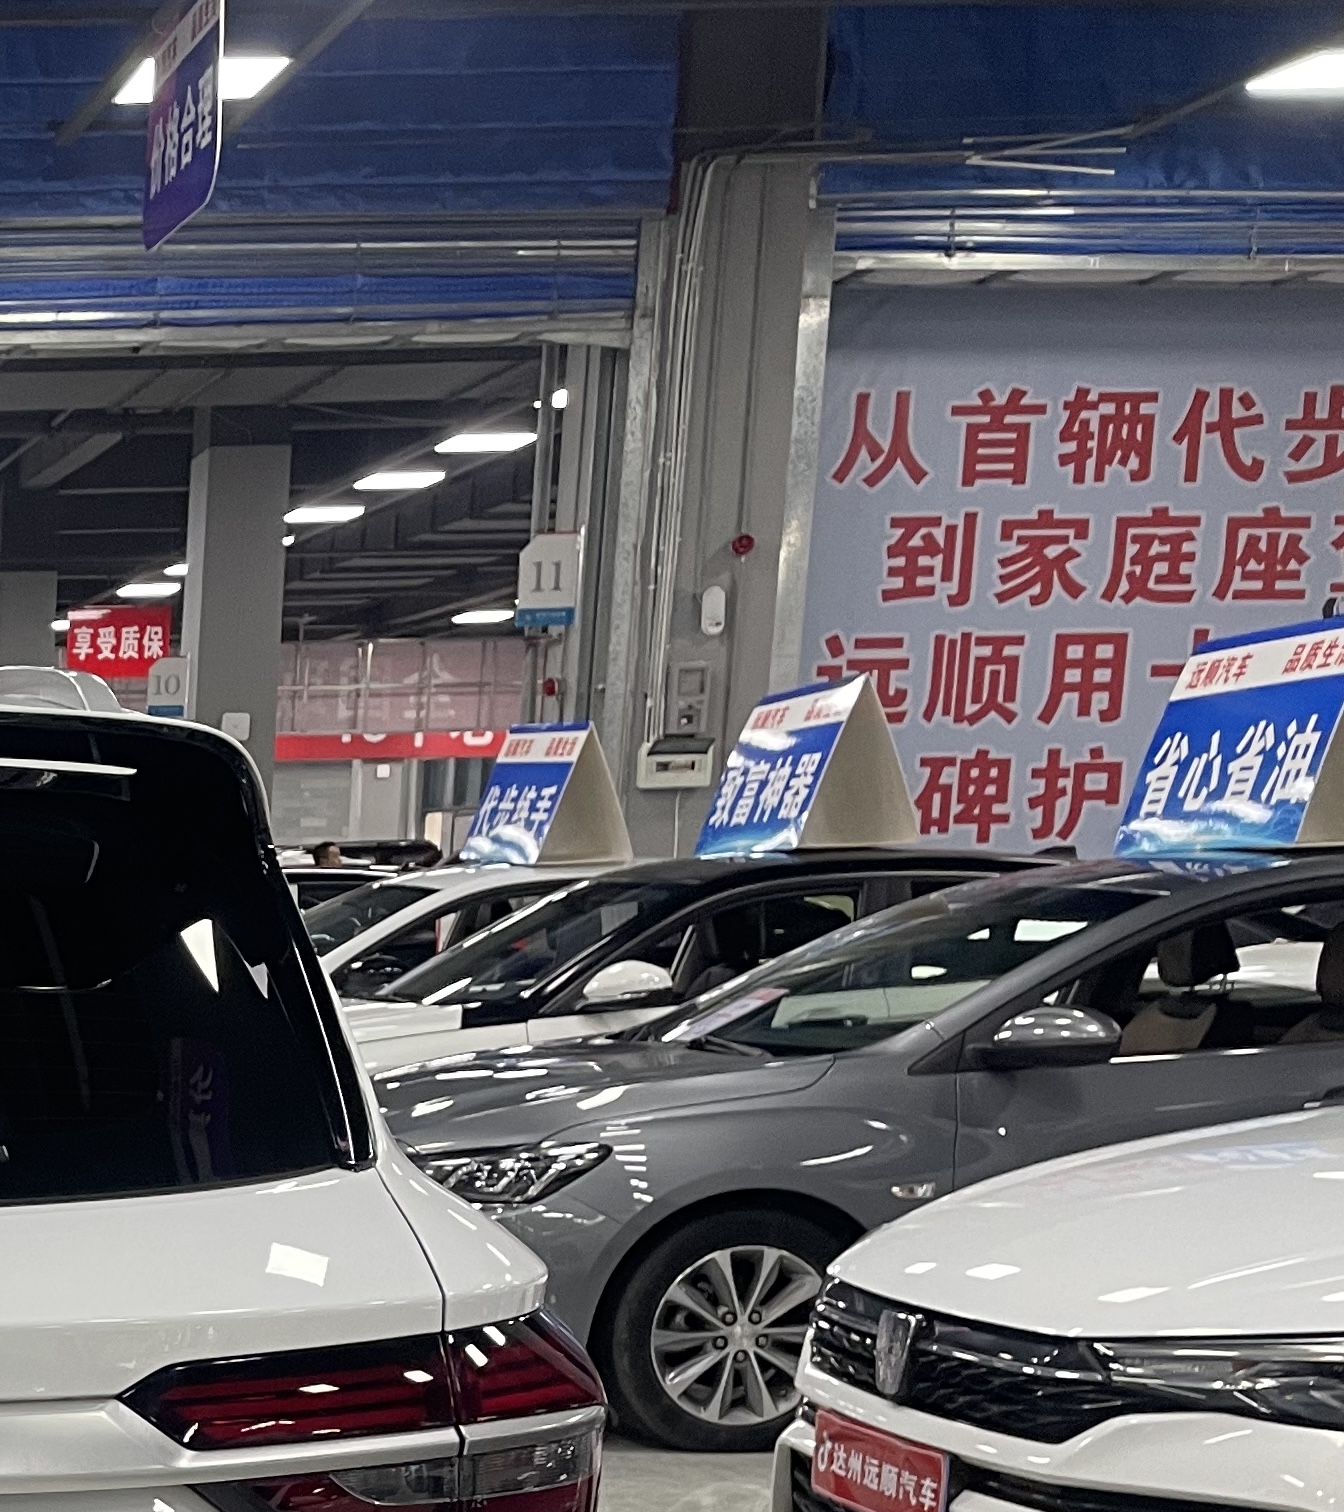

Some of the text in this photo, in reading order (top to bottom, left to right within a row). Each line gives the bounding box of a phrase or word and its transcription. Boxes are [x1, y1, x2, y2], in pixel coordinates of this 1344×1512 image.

[831, 387, 1344, 486] 从首辆代步
[531, 560, 562, 593] 11
[880, 505, 1344, 607] 到家庭座
[72, 625, 164, 661] 享受质保
[1184, 654, 1255, 691] 远顺汽车
[152, 673, 181, 696] 10
[708, 751, 822, 829] 致富神器
[1139, 713, 1323, 819] 省心省油
[830, 1443, 939, 1512] 达州远顺汽车
